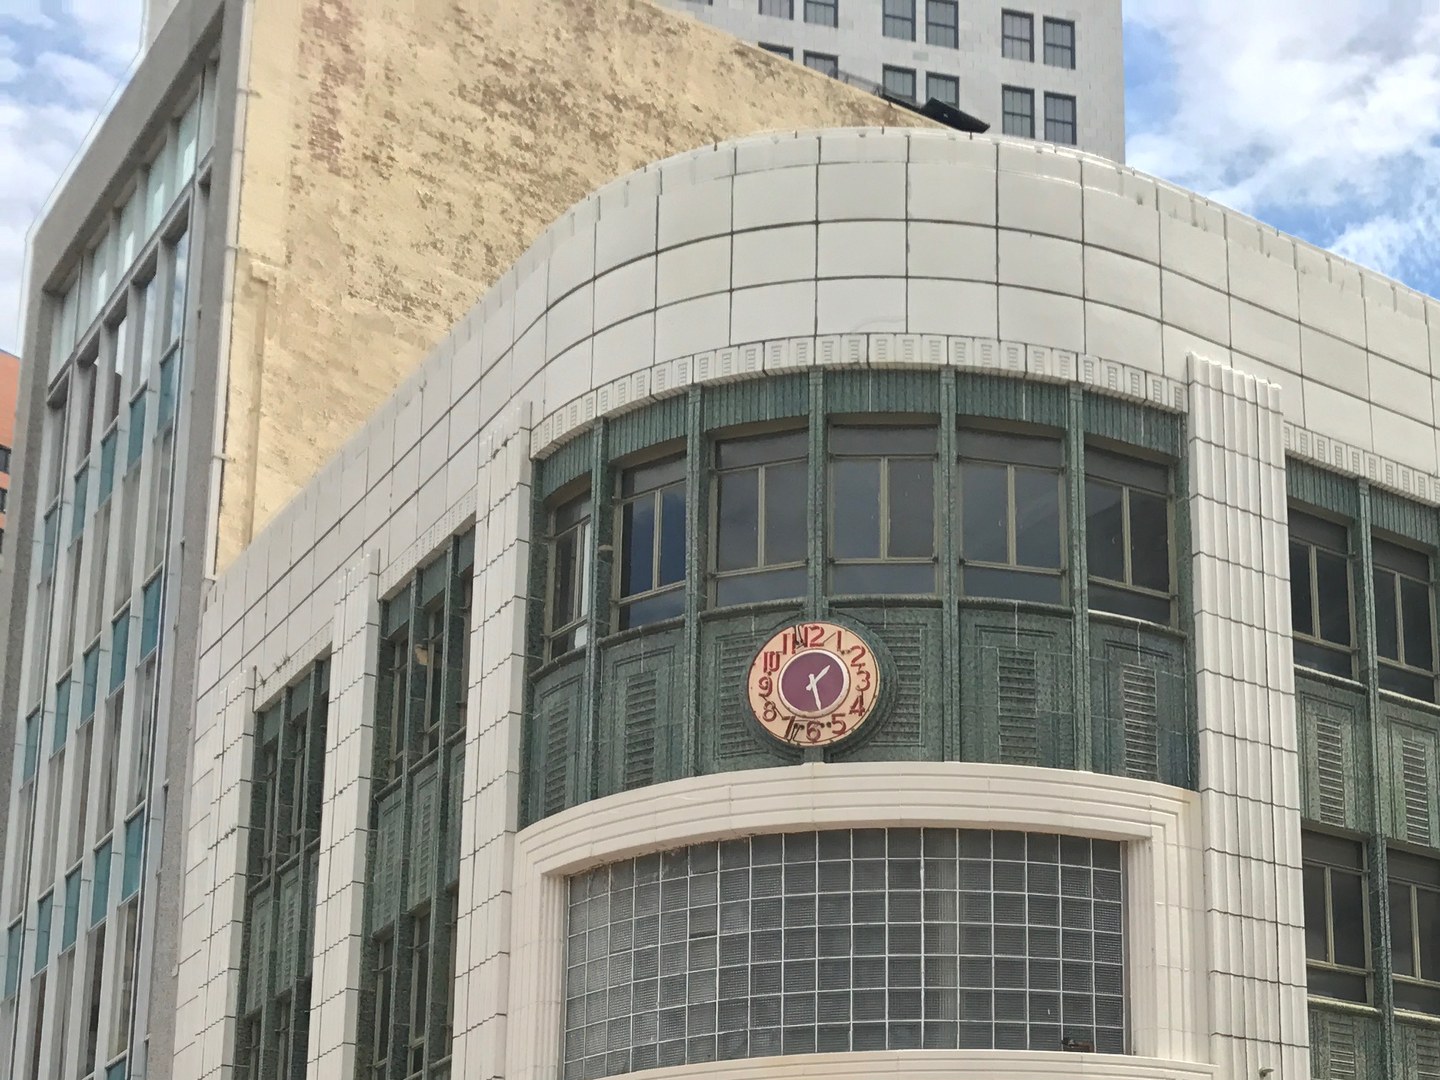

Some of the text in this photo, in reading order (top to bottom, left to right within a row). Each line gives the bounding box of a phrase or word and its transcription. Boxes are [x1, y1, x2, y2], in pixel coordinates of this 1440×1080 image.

[782, 633, 796, 655] 11
[804, 625, 825, 647] 12
[837, 631, 842, 651] 1
[763, 651, 780, 672] 10
[851, 645, 866, 667] 2
[759, 676, 773, 697] 9
[856, 671, 871, 691] 3
[763, 701, 777, 722] 8
[849, 694, 865, 716] 4
[782, 716, 795, 741] 7
[806, 720, 822, 741] 6
[831, 713, 847, 734] 5
